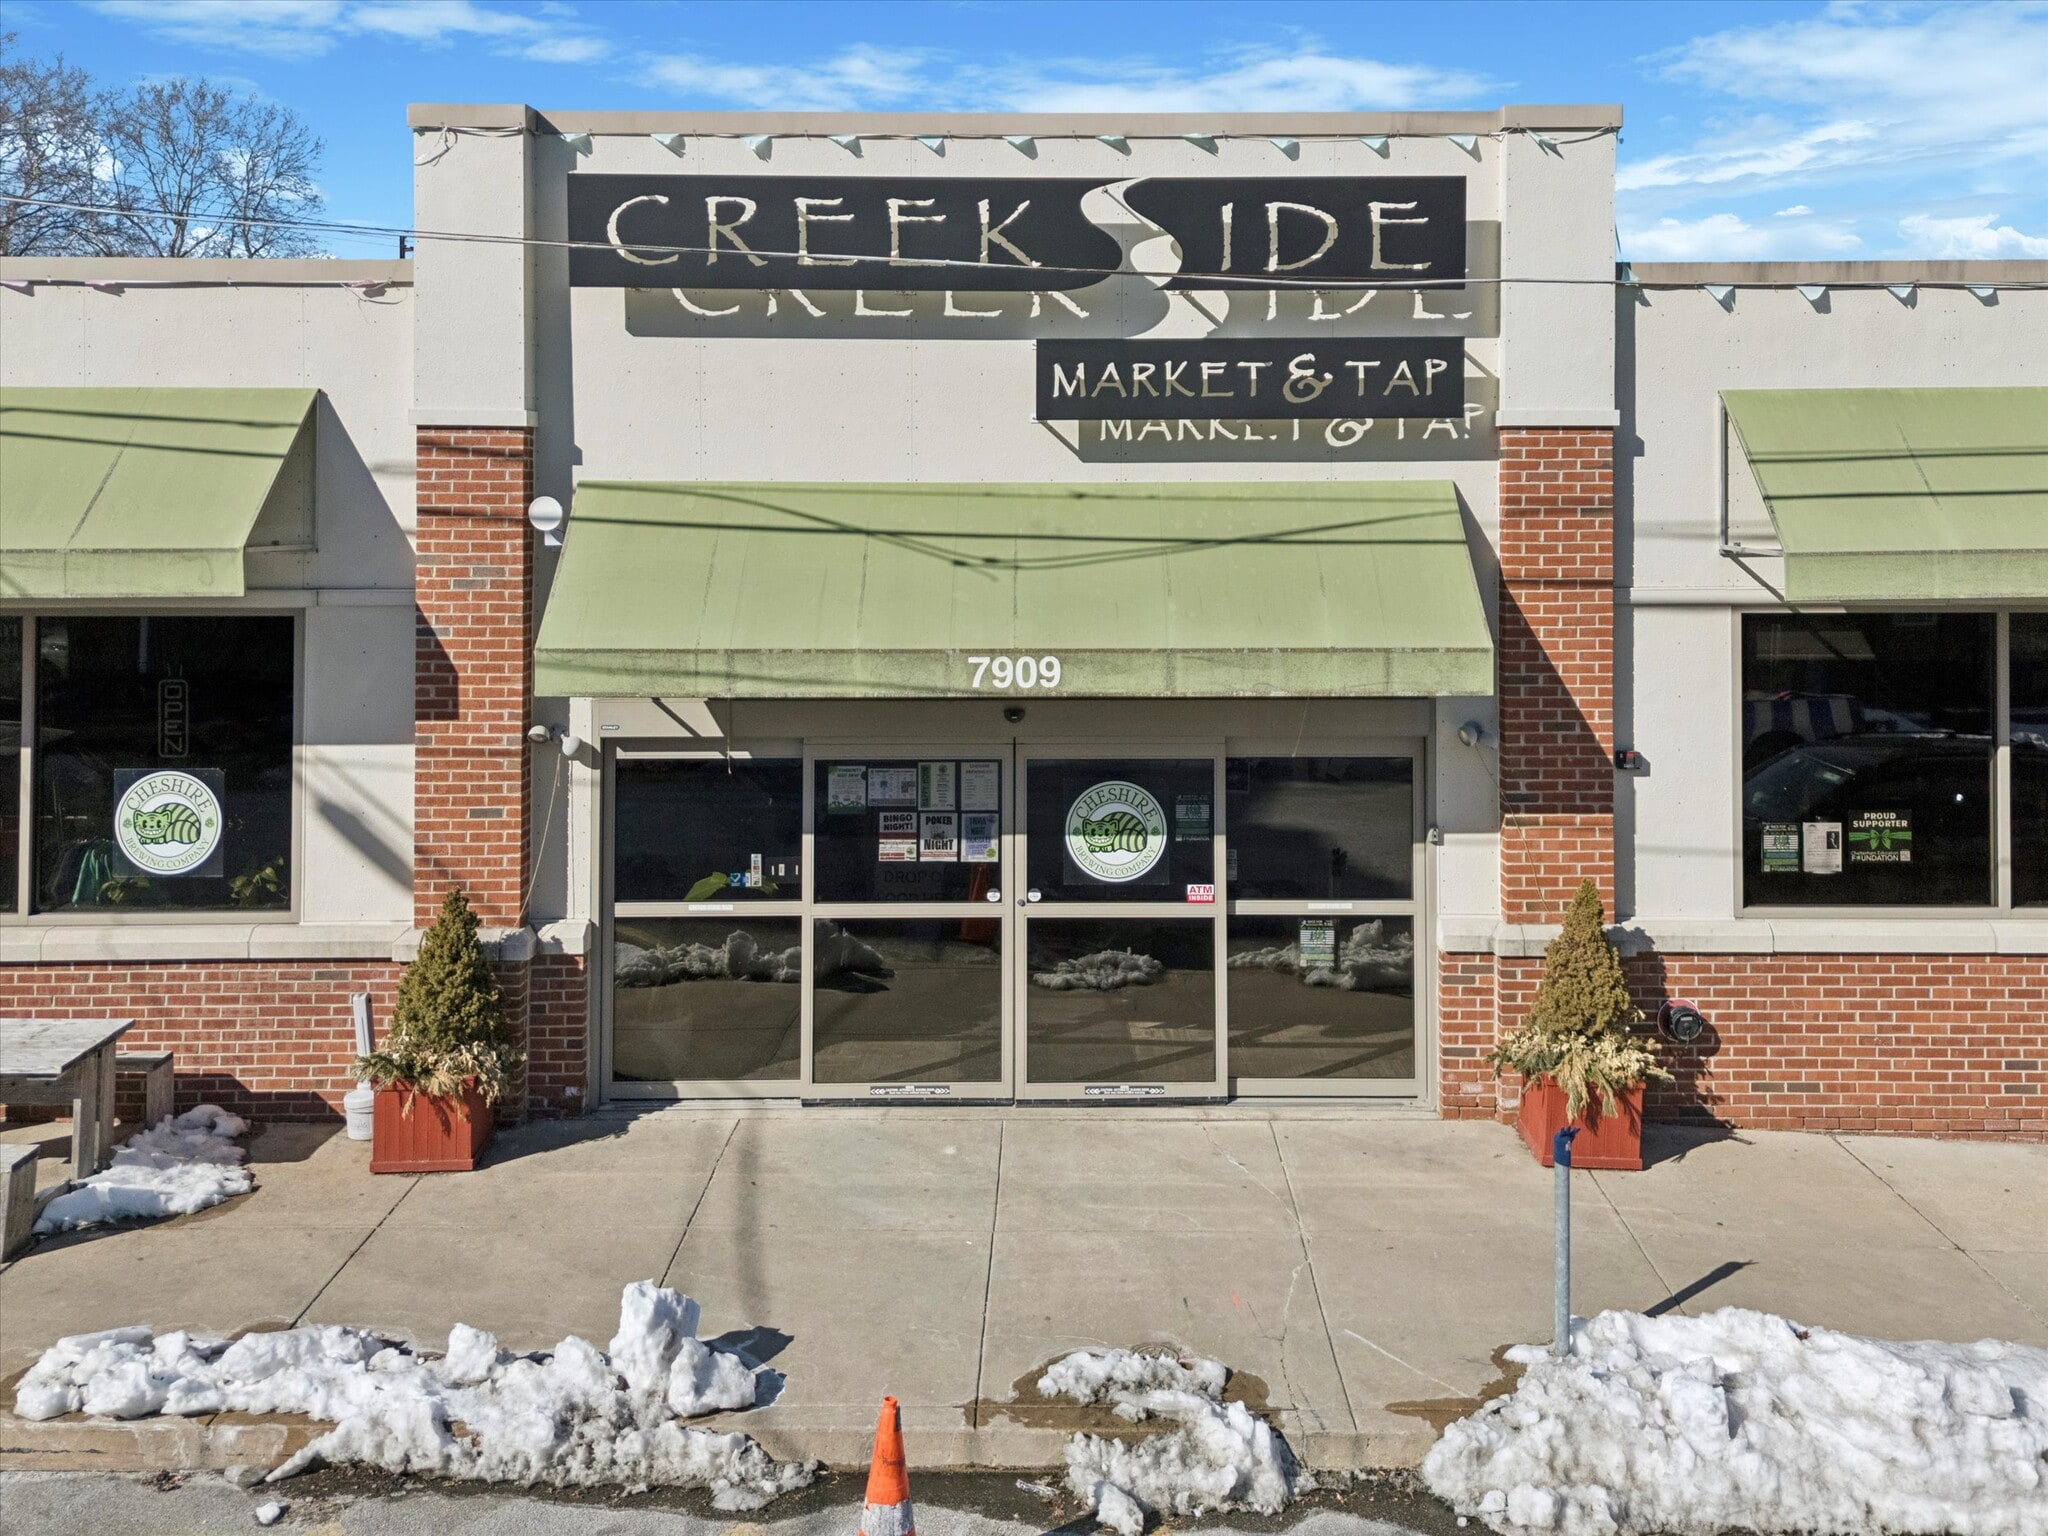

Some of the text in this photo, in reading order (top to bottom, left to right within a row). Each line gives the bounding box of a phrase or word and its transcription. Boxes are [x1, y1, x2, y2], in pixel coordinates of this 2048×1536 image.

[1052, 353, 1448, 403] MARKET & TAP
[967, 655, 1061, 688] 7909
[165, 685, 183, 753] OPEN
[127, 778, 212, 813] CHESHIRE
[1076, 787, 1158, 822] CHESHIRE
[883, 814, 913, 823] BINGO
[883, 823, 913, 831] NIGHT!
[926, 815, 953, 825] POKER
[1853, 820, 1908, 828] SUPPORTER
[1864, 812, 1896, 820] PROUD
[126, 838, 210, 869] BREWING COMPANY
[924, 839, 954, 850] NIGHT
[1076, 845, 1157, 876] BREWING COMPANY
